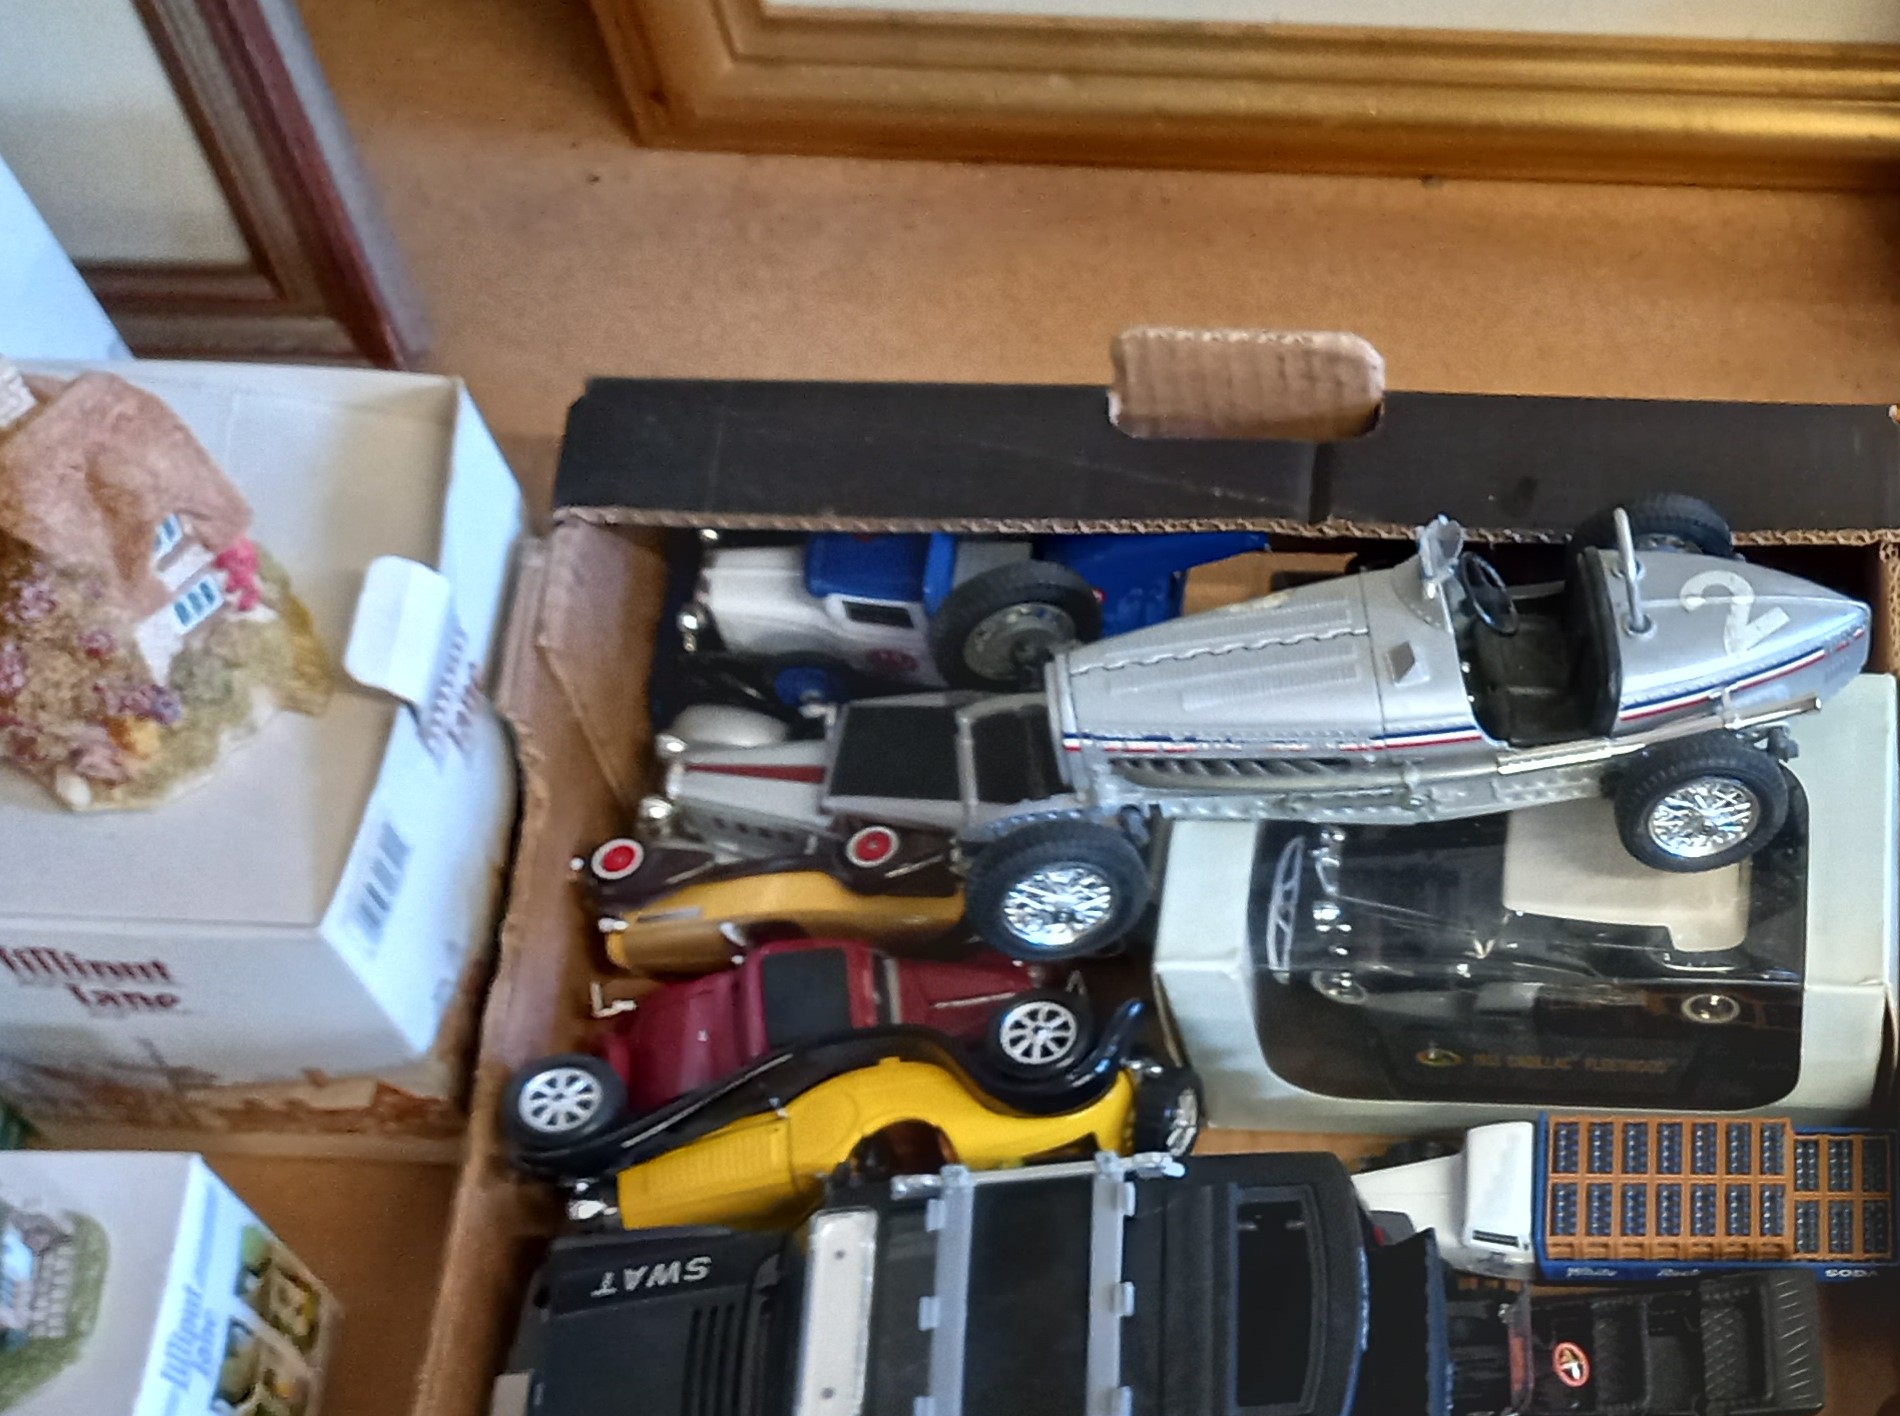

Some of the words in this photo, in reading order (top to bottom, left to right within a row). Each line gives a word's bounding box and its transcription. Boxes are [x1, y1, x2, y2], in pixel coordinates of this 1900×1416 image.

[1680, 569, 1791, 657] 2
[591, 1255, 712, 1297] SWAT
[1824, 1267, 1878, 1279] SODA
